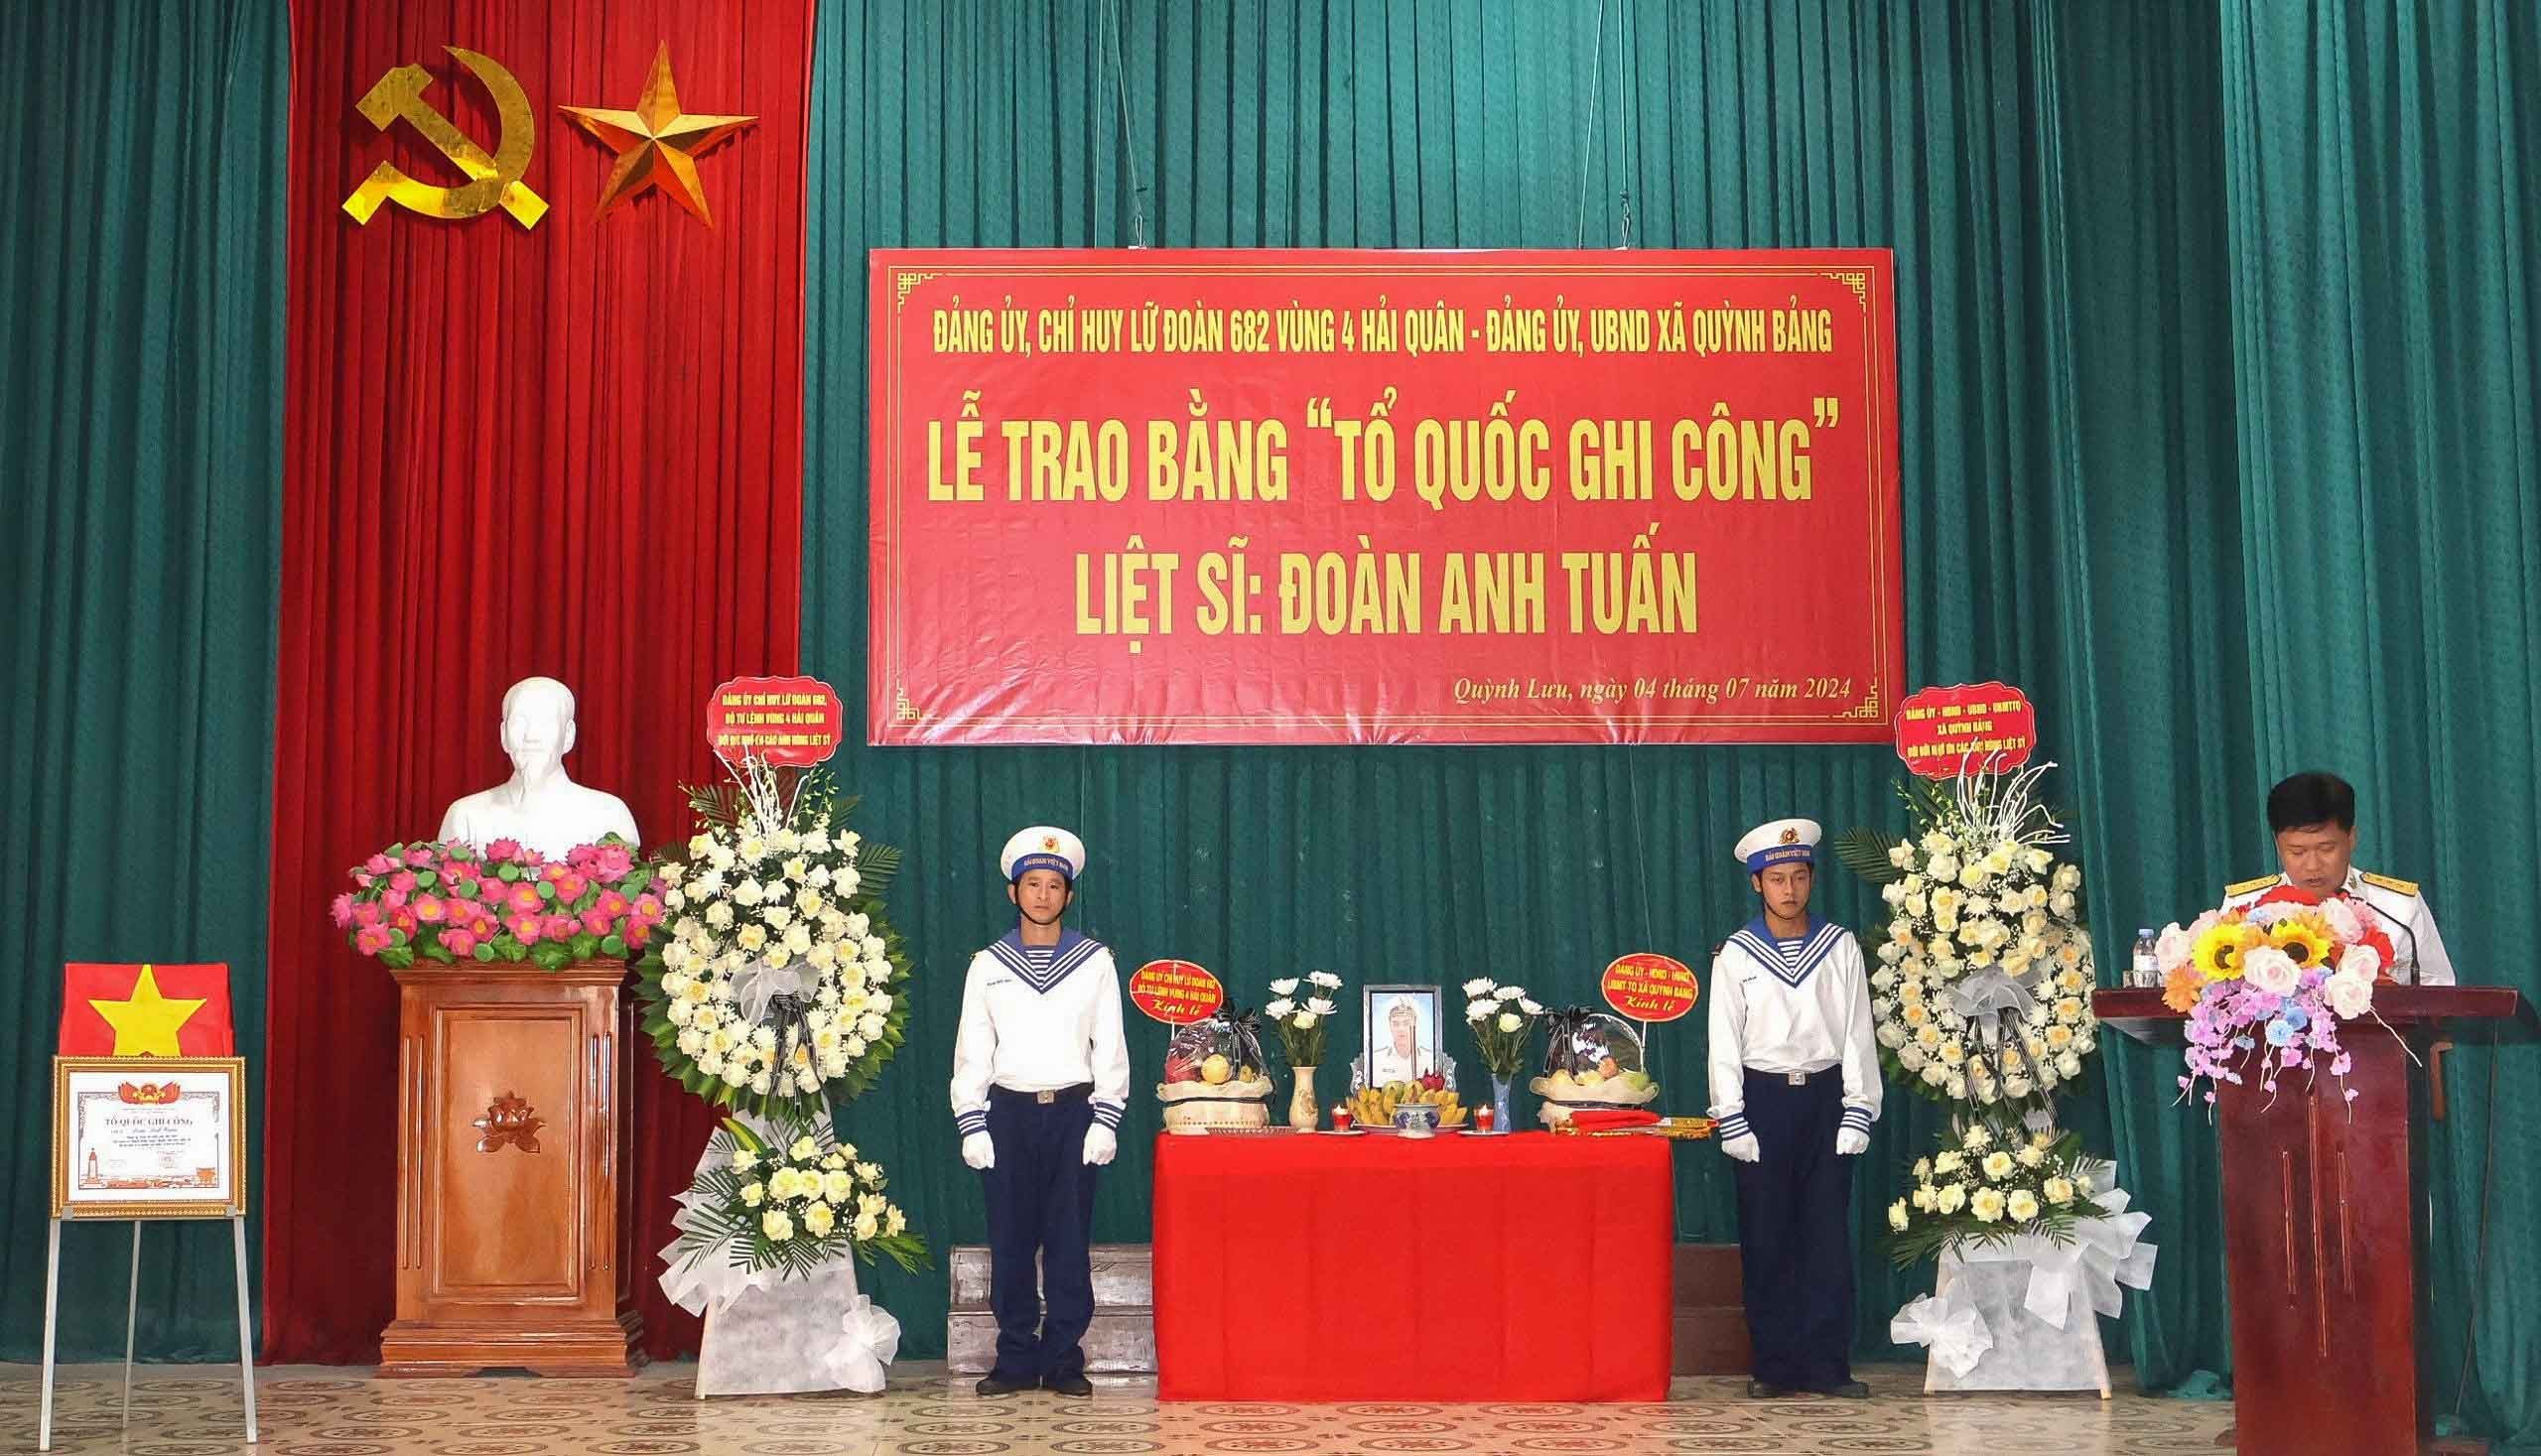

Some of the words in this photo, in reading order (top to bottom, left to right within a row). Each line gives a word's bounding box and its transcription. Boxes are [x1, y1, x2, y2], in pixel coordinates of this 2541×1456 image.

[932, 294, 994, 353] ĐẢNG
[1001, 295, 1032, 357] ỦY,
[1038, 295, 1075, 353] CHỈ
[1082, 309, 1124, 353] HUY
[1131, 301, 1159, 353] LỮ
[1162, 301, 1224, 353] ĐOÀN
[1230, 310, 1270, 353] 682
[1275, 300, 1335, 353] VÙNG
[1341, 310, 1355, 353] 4
[1362, 294, 1398, 353] HẢI
[1404, 301, 1466, 357] QUÂN
[1471, 330, 1480, 339] -
[1486, 295, 1547, 353] ĐẢNG
[1552, 295, 1584, 357] ỦY,
[1590, 309, 1651, 353] UBND
[1657, 301, 1687, 352] XÃ
[1692, 301, 1766, 357] QUỲNH
[1773, 295, 1832, 353] BẢNG
[927, 389, 986, 502] LỄ
[1001, 420, 1130, 503] TRAO
[1147, 387, 1289, 502] BẰNG
[1306, 385, 1398, 502] “TỔ
[1414, 389, 1550, 511] QUỐC
[1568, 418, 1654, 502] GHI
[1671, 396, 1841, 502] CÔNG”
[1075, 534, 1180, 654] LIỆT
[1196, 534, 1263, 636] SĨ:
[1277, 534, 1421, 636] ĐOÀN
[1438, 552, 1545, 635] ANH
[1560, 522, 1697, 635] TUẤN
[1454, 678, 1520, 705] Quỳnh
[1527, 682, 1574, 704] Lưu,
[1580, 681, 1628, 706] ngày
[1634, 683, 1657, 701] 04
[1663, 680, 1719, 706] tháng
[1725, 682, 1749, 701] 07
[1755, 679, 1798, 700] năm
[1804, 679, 1852, 700] 2024
